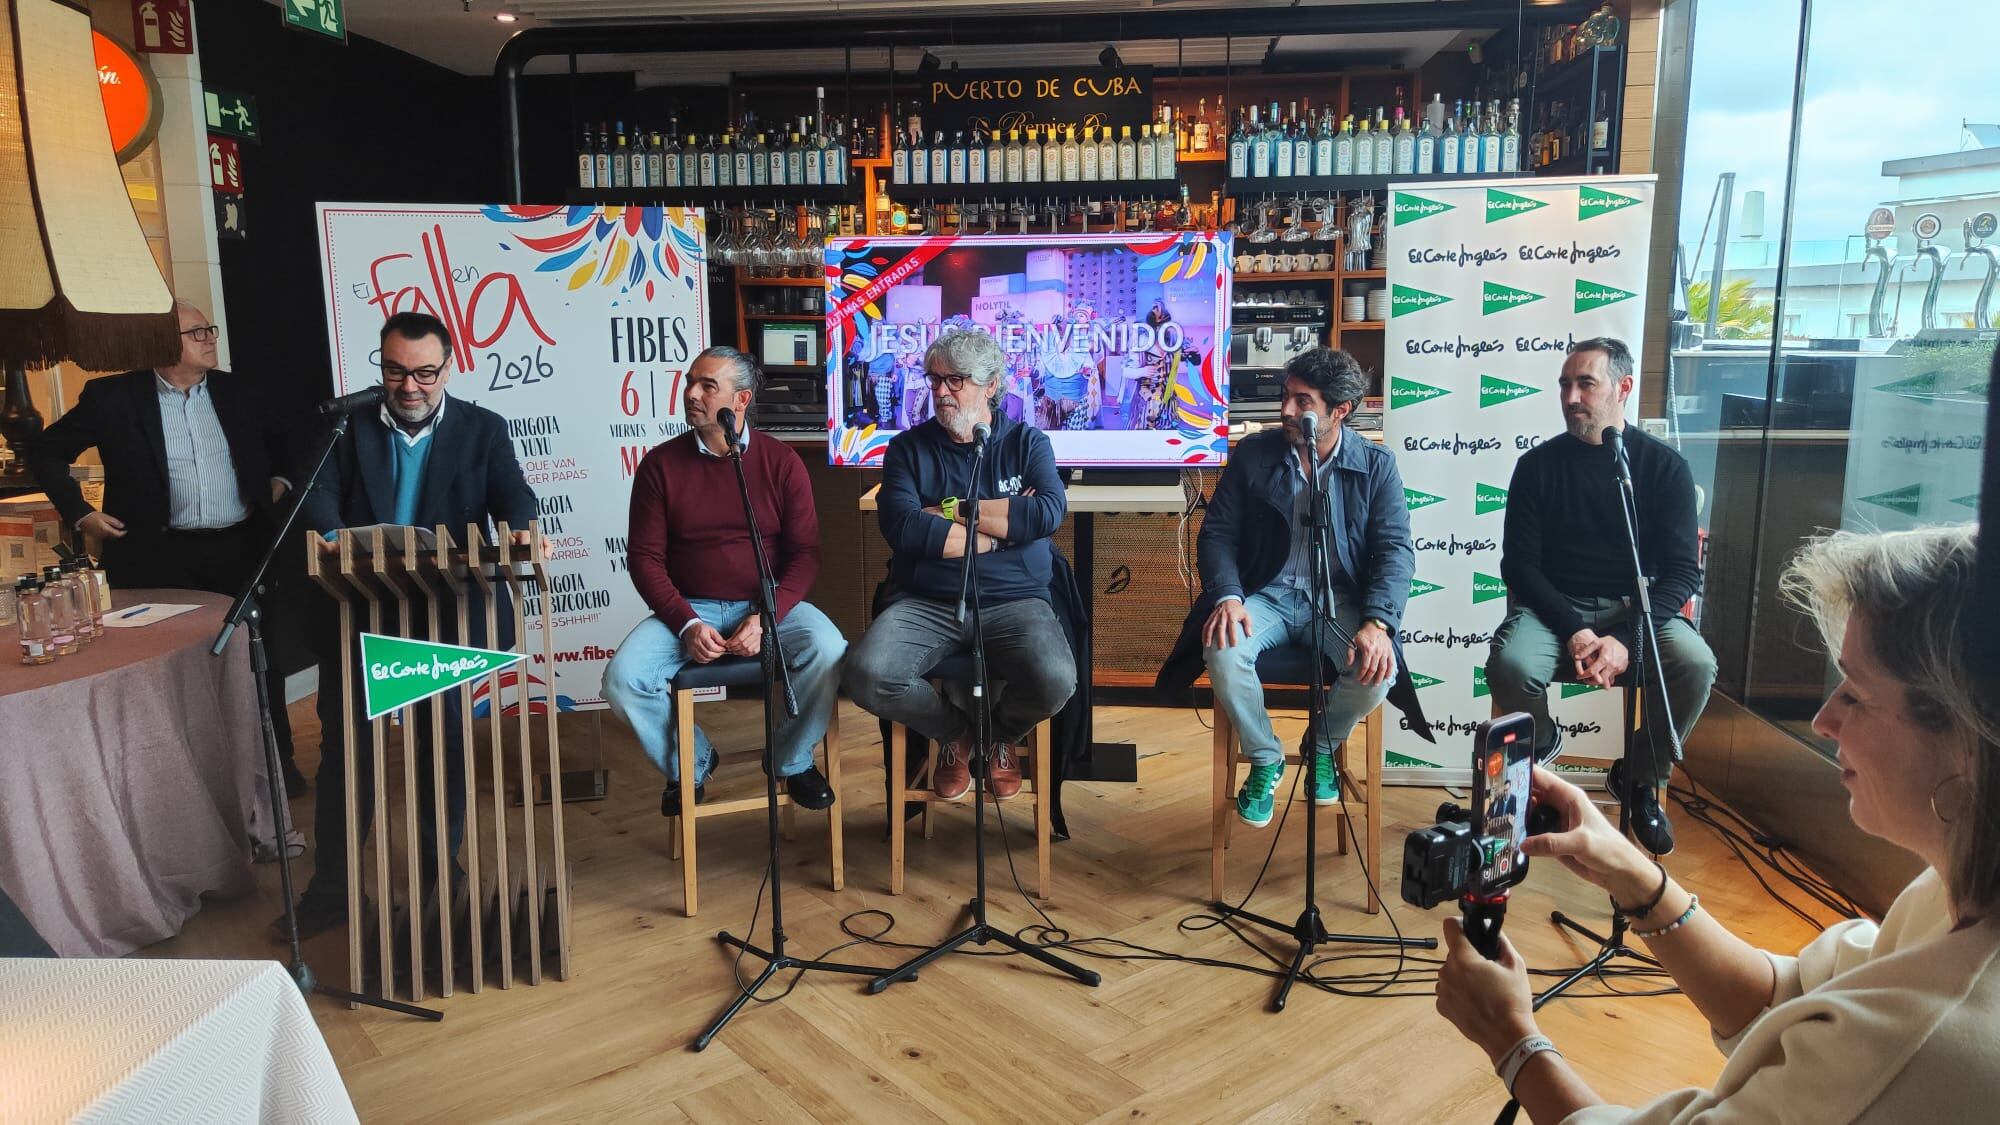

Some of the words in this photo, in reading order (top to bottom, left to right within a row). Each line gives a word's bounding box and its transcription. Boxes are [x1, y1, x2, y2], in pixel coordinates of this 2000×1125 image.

[932, 79, 1023, 104] PUERTO
[1036, 78, 1061, 98] DE
[1073, 77, 1143, 97] CUBA
[1408, 248, 1422, 263] El
[1423, 248, 1457, 263] Corte
[1458, 243, 1508, 268] Inglés
[1518, 245, 1533, 260] El
[1535, 245, 1568, 260] Corte
[1570, 240, 1620, 264] Inglés
[353, 283, 370, 299] El
[452, 265, 480, 283] en
[866, 257, 920, 299] ENTRADAS
[610, 317, 689, 363] FIBES
[865, 317, 958, 363] JESÚ
[973, 321, 1185, 355] IENVENIDO
[1406, 339, 1420, 354] El
[1421, 339, 1454, 354] Corte
[1456, 335, 1505, 358] Inglés
[1515, 337, 1530, 352] El
[1531, 337, 1564, 352] Corte
[487, 345, 554, 391] 2026
[621, 370, 640, 417] 6
[664, 370, 683, 416] 7
[508, 416, 560, 438] IRIGOTA
[609, 423, 647, 438] VIERNES
[520, 437, 552, 457] YUYU
[1404, 436, 1418, 451] El
[1419, 436, 1452, 451] Corte
[1453, 432, 1502, 455] Inglés
[1515, 435, 1529, 450] El
[526, 460, 549, 471] QUE
[552, 458, 576, 469] VAN
[526, 472, 549, 485] GER
[536, 495, 573, 516] IGOTA
[552, 537, 584, 549] EMOS
[605, 537, 628, 553] MAN
[1415, 538, 1447, 551] Corte
[1449, 533, 1496, 556] Inglés
[610, 559, 617, 573] Y
[551, 589, 610, 614] BIZCOCHO
[1400, 630, 1412, 644] El
[1413, 630, 1445, 644] Corte
[533, 646, 615, 664] www.fibe
[371, 662, 389, 680] El
[389, 661, 430, 679] Corte
[431, 653, 489, 680] Inglés
[1426, 720, 1446, 731] rte
[1447, 715, 1480, 736] Ingl
